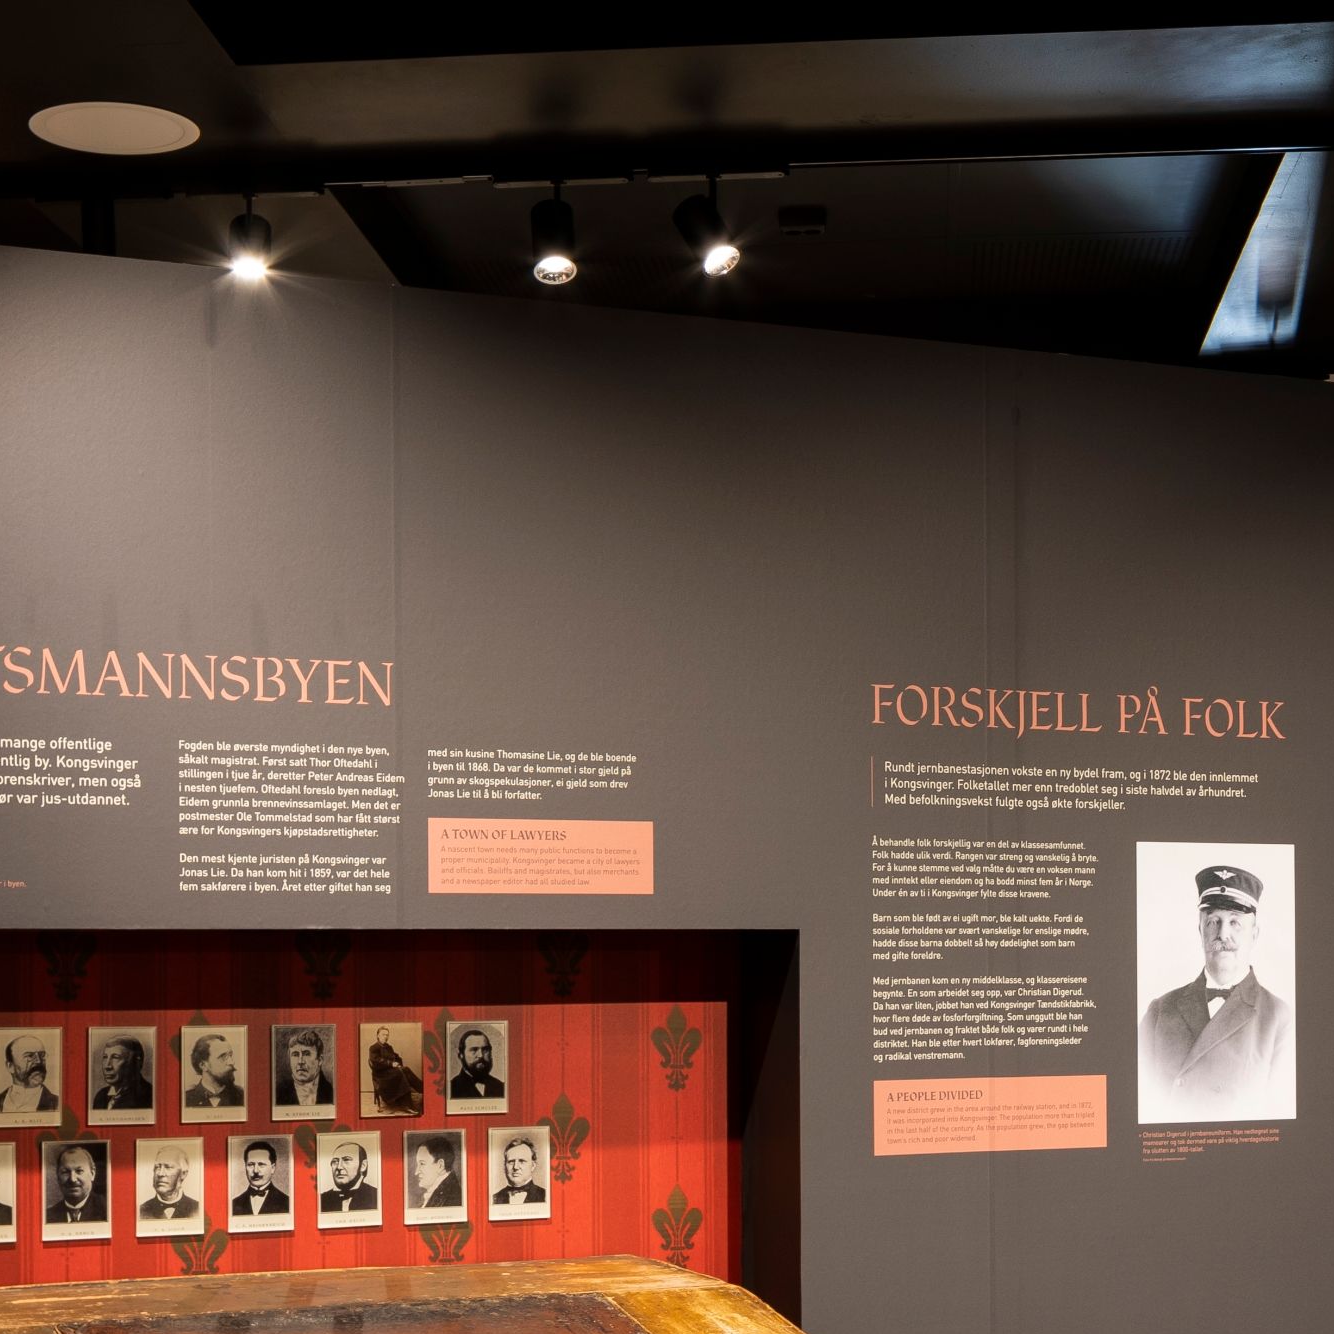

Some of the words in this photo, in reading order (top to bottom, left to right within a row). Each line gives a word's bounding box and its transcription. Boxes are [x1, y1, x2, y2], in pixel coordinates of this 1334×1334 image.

[871, 684, 1102, 738] FORSKJELL
[1117, 685, 1167, 735] PÅ
[1182, 698, 1284, 739] FOLK
[0, 738, 46, 752] mange
[49, 736, 112, 754] offentlige
[34, 754, 52, 770] by.
[56, 755, 138, 772] Kongsvinger
[78, 776, 107, 787] men
[110, 773, 141, 791] også
[884, 776, 887, 788] i
[890, 777, 954, 792] Kongsvinger.
[957, 778, 1009, 791] Folketallet
[1012, 783, 1032, 792] mer
[1034, 784, 1053, 792] enn
[1055, 782, 1099, 794] tredoblet
[1100, 785, 1118, 797] seg
[1120, 783, 1123, 794] i
[1125, 784, 1148, 795] siste
[1150, 784, 1184, 796] halvdel
[1185, 788, 1197, 796] av
[1198, 784, 1246, 798] århundret.
[16, 794, 38, 804] var
[41, 791, 129, 807] jus-utdannet.
[427, 788, 454, 798] Jonas
[456, 788, 470, 798] Lie
[472, 789, 482, 799] til
[483, 788, 489, 799] å
[491, 789, 502, 799] bli
[504, 790, 542, 800] forfatter.
[884, 793, 906, 804] Med
[909, 793, 993, 808] befolkningsvekst
[995, 795, 1023, 810] fulgte
[1025, 795, 1049, 810] også
[1051, 797, 1073, 809] økte
[1075, 797, 1125, 812] forskjeller.
[178, 811, 234, 822] postmester
[236, 811, 252, 821] Ole
[254, 811, 312, 822] Tommelstad
[314, 815, 335, 823] som
[337, 813, 353, 823] har
[355, 812, 371, 823] fått
[373, 814, 400, 824] størst
[441, 829, 449, 839] A
[451, 829, 488, 839] TOWN
[491, 829, 507, 840] OF
[510, 829, 567, 841] LAWYERS
[872, 951, 890, 960] med
[891, 950, 909, 962] gifte
[910, 950, 943, 960] foreldre.
[873, 1054, 883, 1063] og
[884, 1051, 912, 1061] radikal
[913, 1051, 965, 1060] venstremann.
[887, 1092, 894, 1102] A
[896, 1091, 936, 1102] PEOPLE
[938, 1090, 983, 1100] DIVIDED
